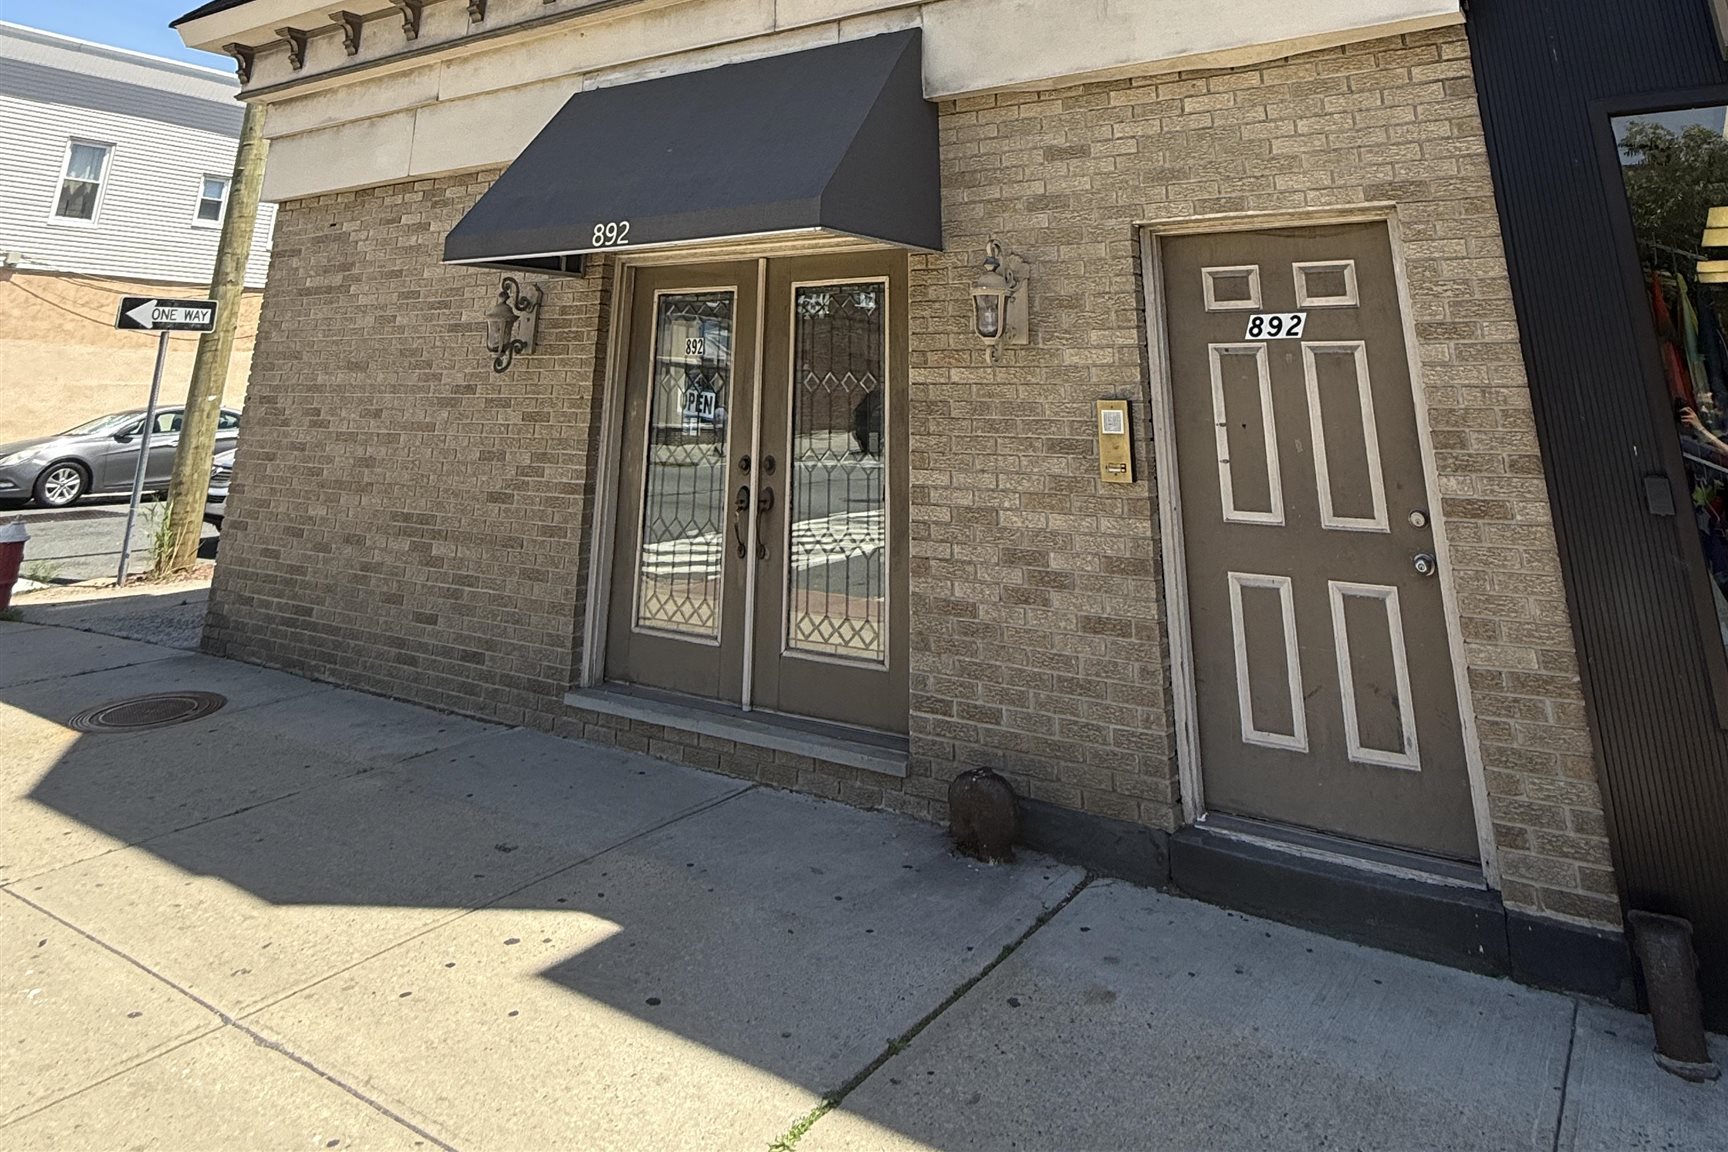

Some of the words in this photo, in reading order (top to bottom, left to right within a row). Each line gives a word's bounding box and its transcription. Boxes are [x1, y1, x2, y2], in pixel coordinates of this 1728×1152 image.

[592, 221, 630, 247] 892
[152, 307, 178, 321] ONE
[184, 309, 209, 322] WAY
[1248, 314, 1302, 338] 892
[685, 338, 703, 355] 892
